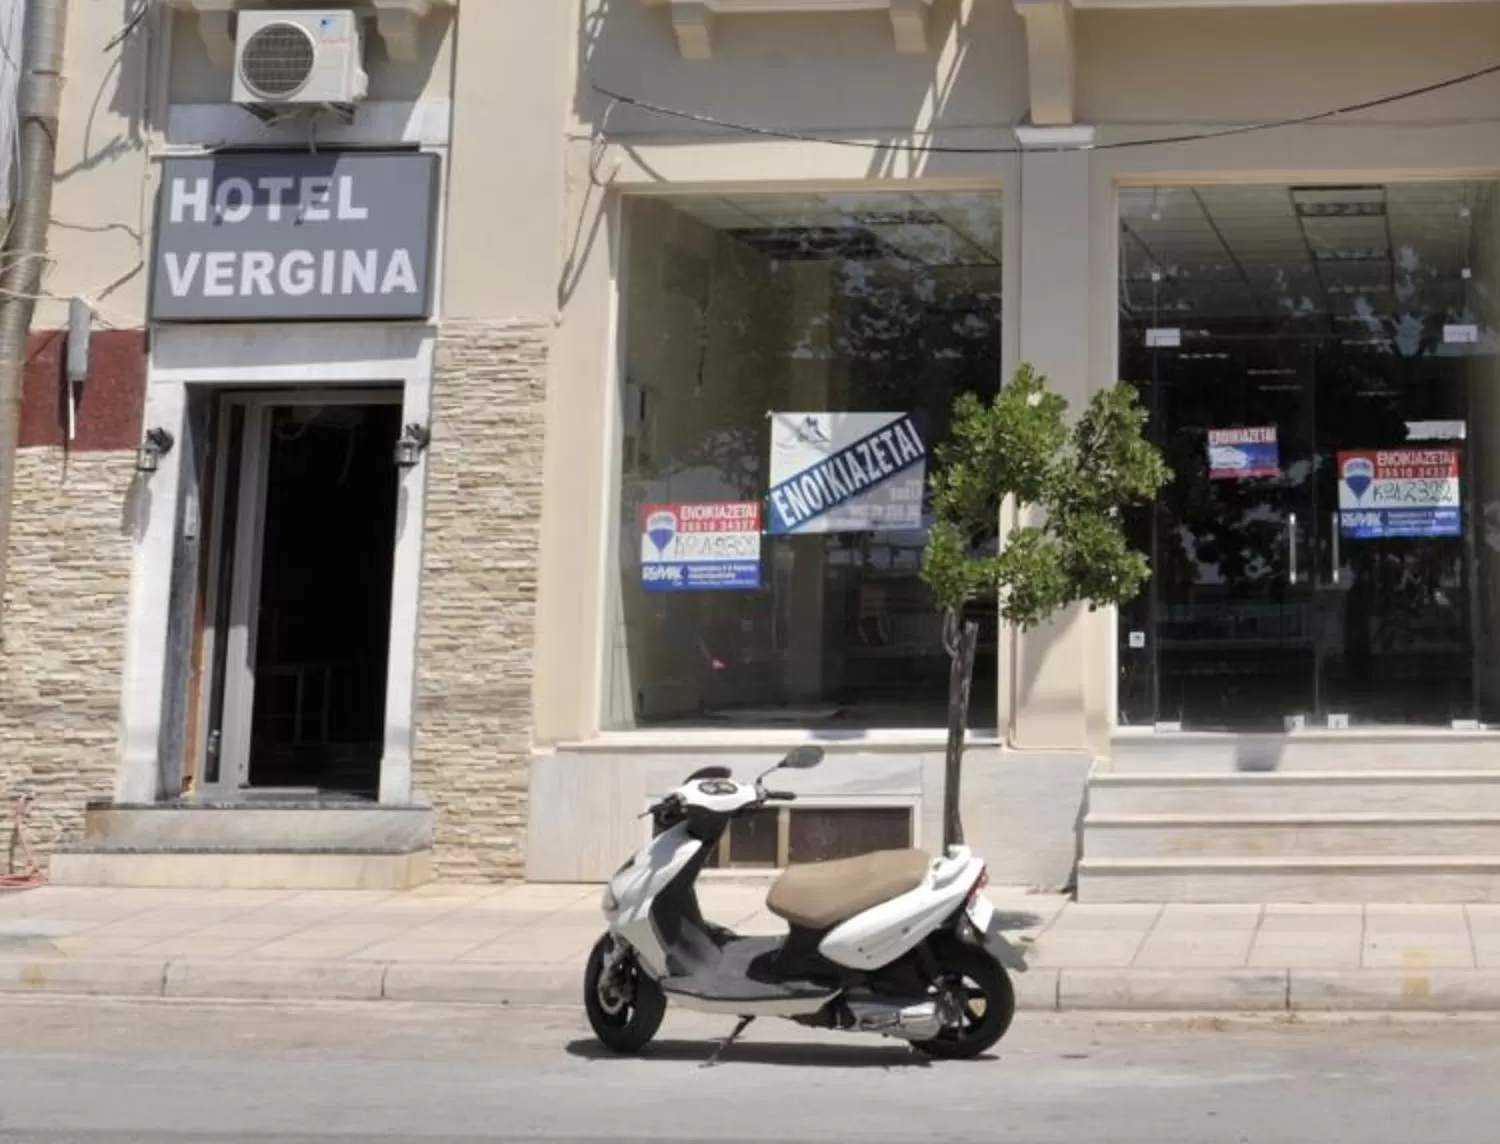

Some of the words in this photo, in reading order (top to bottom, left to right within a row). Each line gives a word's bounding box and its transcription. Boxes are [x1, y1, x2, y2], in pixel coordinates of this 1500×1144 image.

[169, 175, 369, 225] HOTEL
[164, 248, 419, 297] VERGINA
[770, 416, 926, 528] ΕΝΟΙΚΙΑΖΕΤΑΙ
